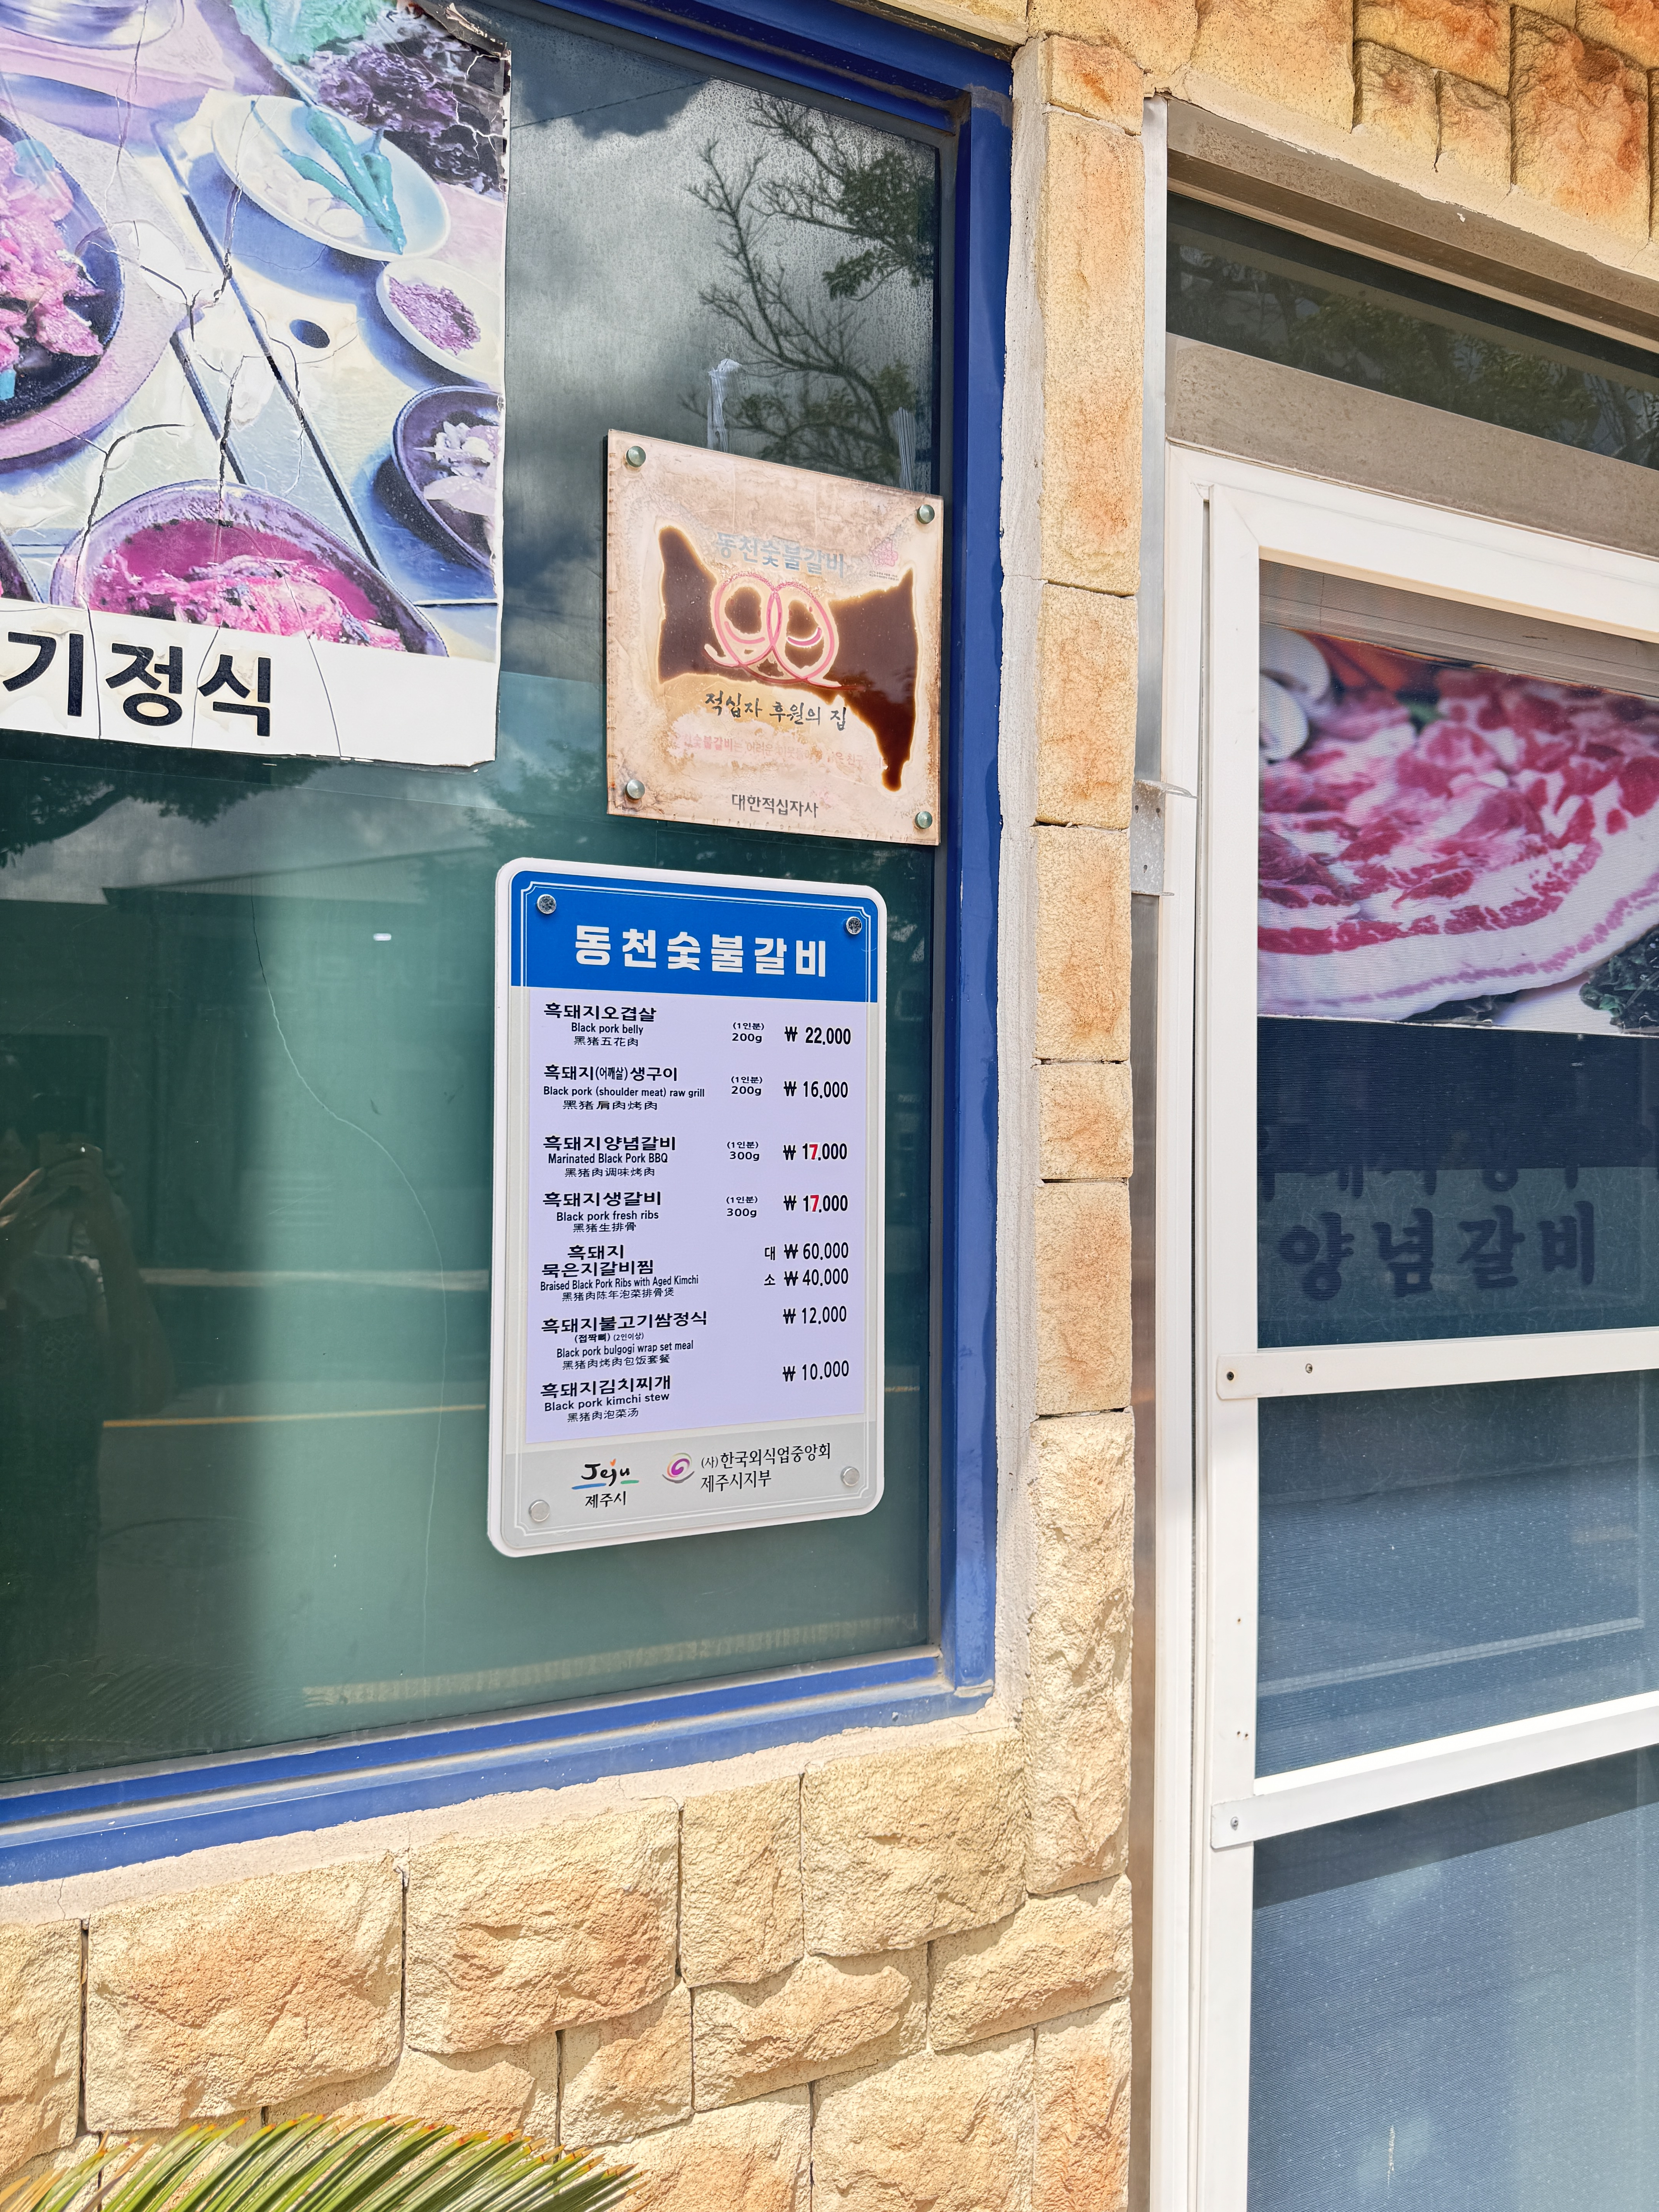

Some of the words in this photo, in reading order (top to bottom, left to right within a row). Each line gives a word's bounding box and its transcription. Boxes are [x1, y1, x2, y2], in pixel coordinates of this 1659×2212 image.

[717, 532, 843, 579] 동천숯불갈비
[3, 631, 271, 737] 기정식
[705, 690, 763, 718] 적십자
[769, 701, 821, 726] 후원의
[830, 707, 847, 731] 집
[732, 794, 819, 818] 대한적십자사
[575, 924, 827, 977] 동천숯불갈비
[544, 1002, 657, 1022] 흑돼지오겹살
[572, 1022, 596, 1032] Black
[599, 1024, 619, 1034] pork
[622, 1024, 644, 1036] belly
[733, 1022, 764, 1030] (1인분)
[732, 1033, 762, 1043] 200g
[731, 1076, 763, 1084] (1인분)
[544, 1086, 568, 1095] Black
[572, 1087, 592, 1097] pork
[596, 1086, 639, 1097] (shoulder
[641, 1087, 666, 1097] meat)
[688, 1088, 704, 1098] grill
[731, 1086, 761, 1096] 200g
[543, 1135, 675, 1151] 흑돼지양념갈비
[548, 1153, 595, 1164] Marinated
[598, 1153, 623, 1163] Black
[625, 1152, 646, 1163] Pork
[649, 1152, 668, 1163] BBQ
[730, 1151, 759, 1161] 300g
[543, 1191, 661, 1207] 흑돼지생갈비
[726, 1196, 758, 1204] (1인분)
[556, 1211, 584, 1221] Black
[587, 1211, 610, 1222] pork
[613, 1210, 637, 1220] fresh
[641, 1210, 659, 1219] ribs
[726, 1208, 757, 1218] 300g
[567, 1244, 623, 1261] 흑돼지
[764, 1246, 775, 1261] 대
[1278, 1200, 1594, 1300] 양념갈비
[541, 1259, 653, 1279] 묵은지갈비찜
[541, 1280, 570, 1291] Braised
[572, 1279, 593, 1290] Black
[595, 1278, 613, 1288] Pork
[615, 1278, 632, 1288] Ribs
[634, 1277, 650, 1286] with
[652, 1276, 672, 1287] Aged
[674, 1274, 699, 1285] Kimchi
[764, 1274, 776, 1286] 소
[541, 1311, 706, 1334] 흑돼지불고기쌈정식
[613, 1332, 644, 1341] (2인이상)
[557, 1347, 579, 1358] Black
[582, 1346, 601, 1358] pork
[604, 1343, 635, 1355] bulgogi
[637, 1345, 658, 1353] wrap
[660, 1342, 672, 1351] set
[675, 1340, 693, 1350] meal
[540, 1375, 670, 1398] 흑돼지김치찌개
[544, 1400, 574, 1412] Black
[578, 1398, 603, 1410] pork
[606, 1394, 641, 1406] kimchi
[645, 1393, 670, 1402] stew
[580, 1458, 631, 1487] Jeju
[700, 1470, 772, 1492] 제주시지부
[585, 1491, 627, 1509] 제주시
